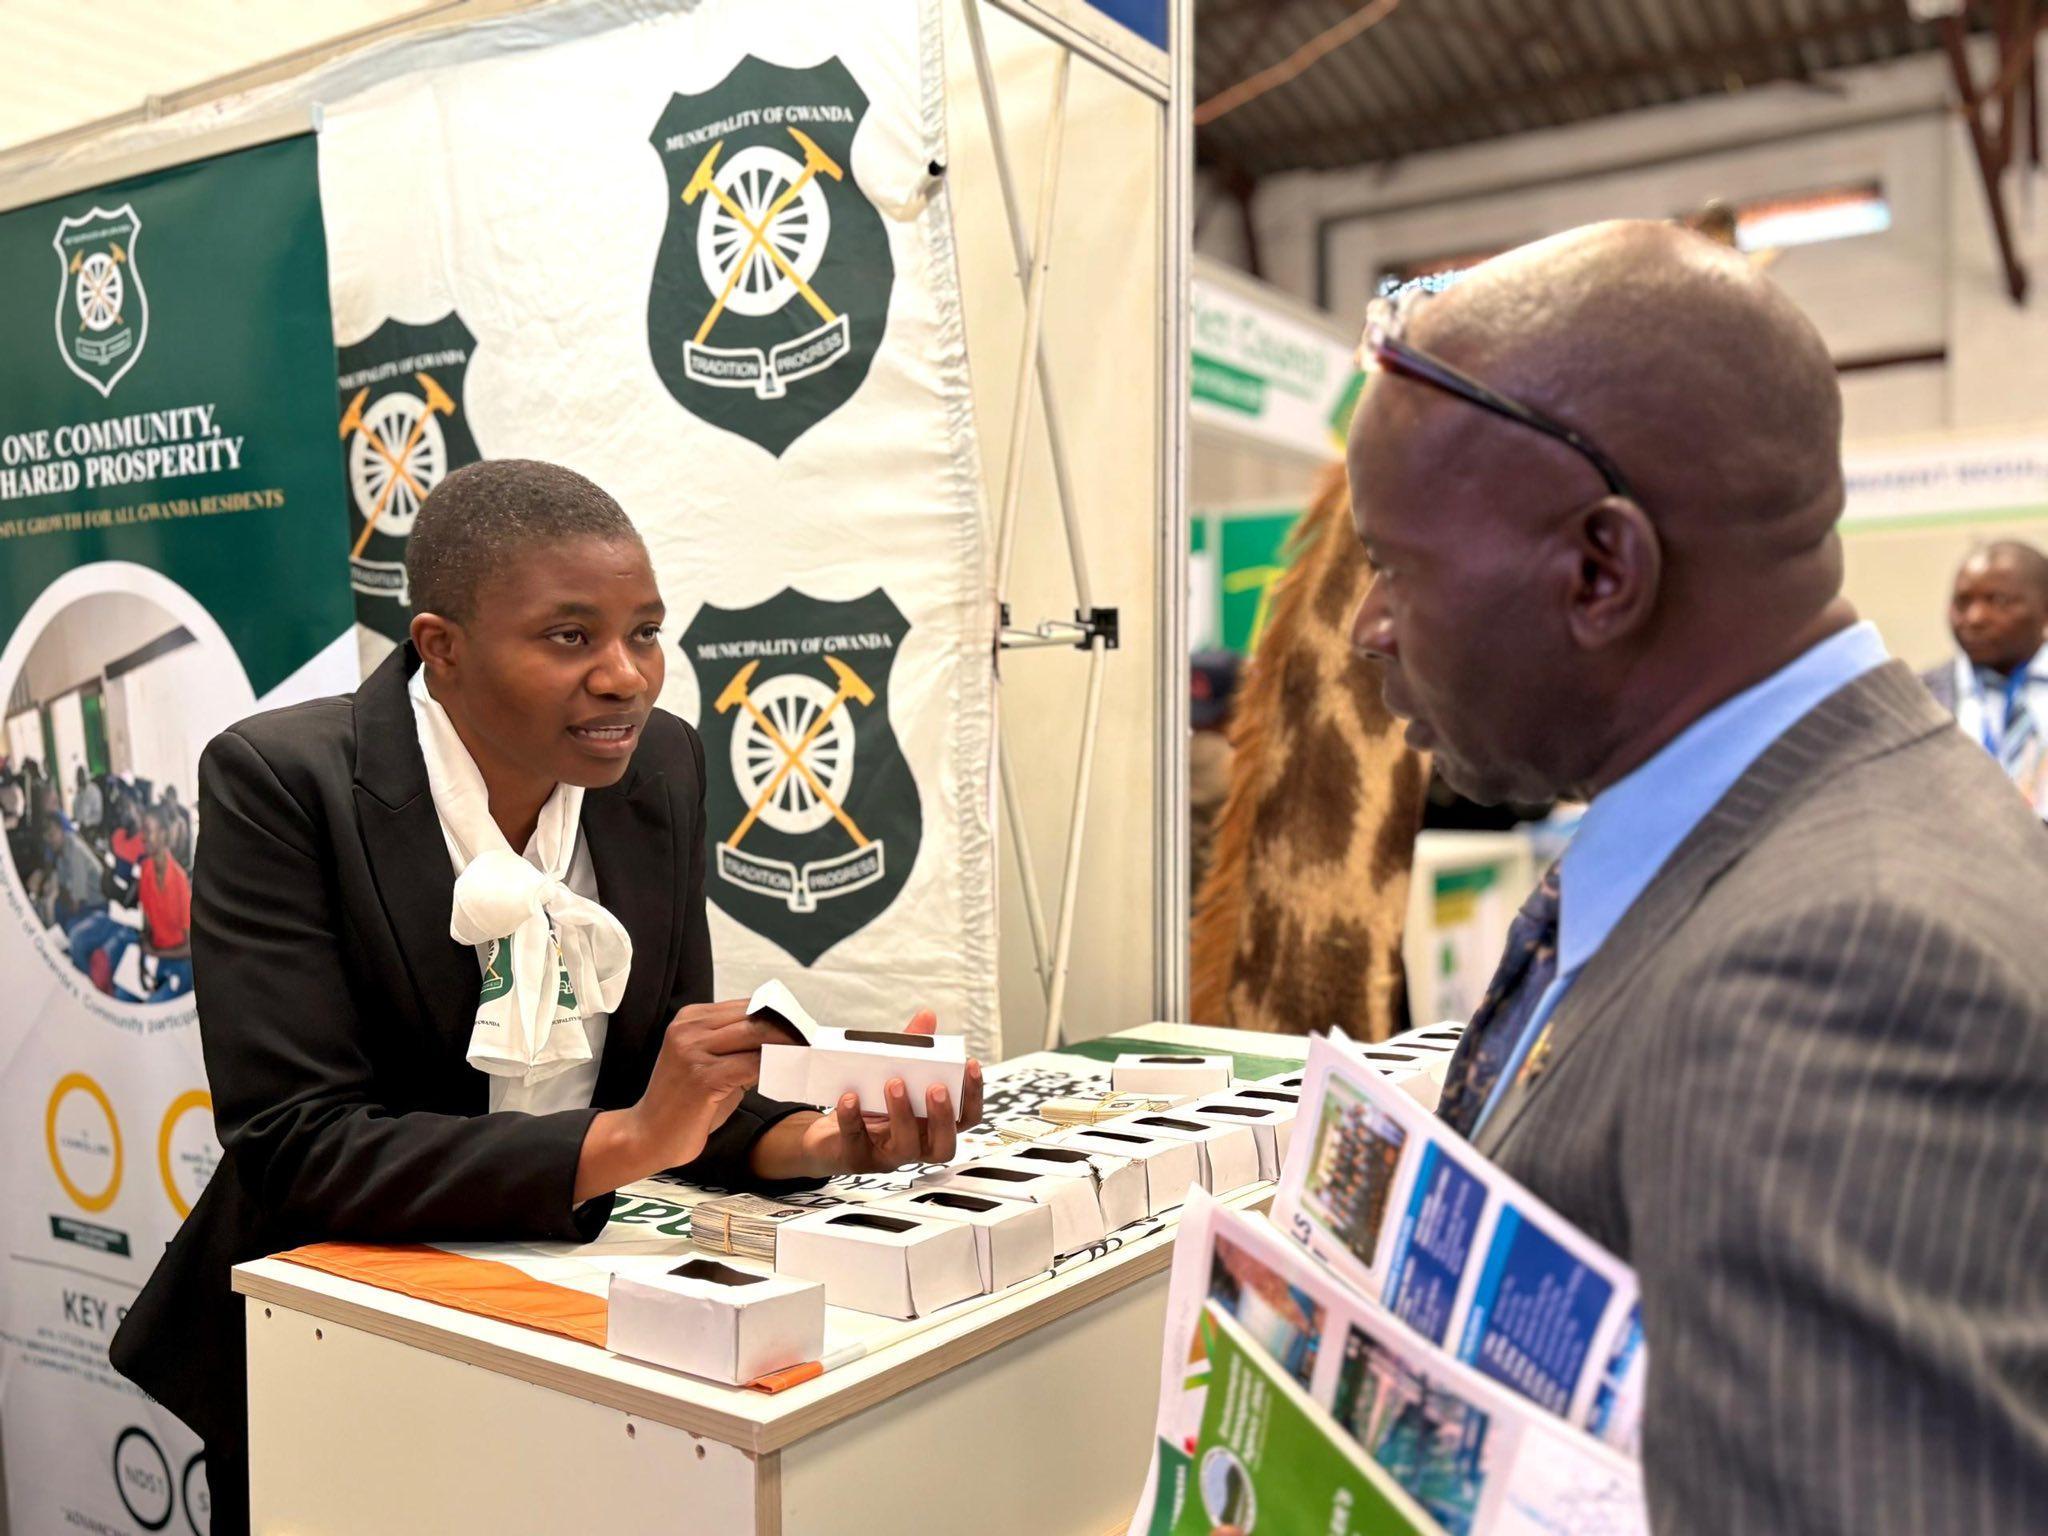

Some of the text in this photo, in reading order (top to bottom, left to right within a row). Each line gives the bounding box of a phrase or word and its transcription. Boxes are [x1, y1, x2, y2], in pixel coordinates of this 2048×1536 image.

[664, 105, 854, 152] MUNICIPALITY OF GWANDA
[691, 332, 843, 378] TRADITION PROGRESS
[2, 403, 221, 467] ONE COMMUNITY,
[0, 436, 244, 500] HARED PROSPERITY
[26, 511, 82, 536] GROWTH
[83, 508, 112, 531] FOR
[200, 488, 285, 516] RESIDENTS
[697, 633, 893, 660] MUNICIPALITY OF GWANDA
[724, 855, 878, 890] TRADITION PROGRESS
[63, 1290, 107, 1331] KEY
